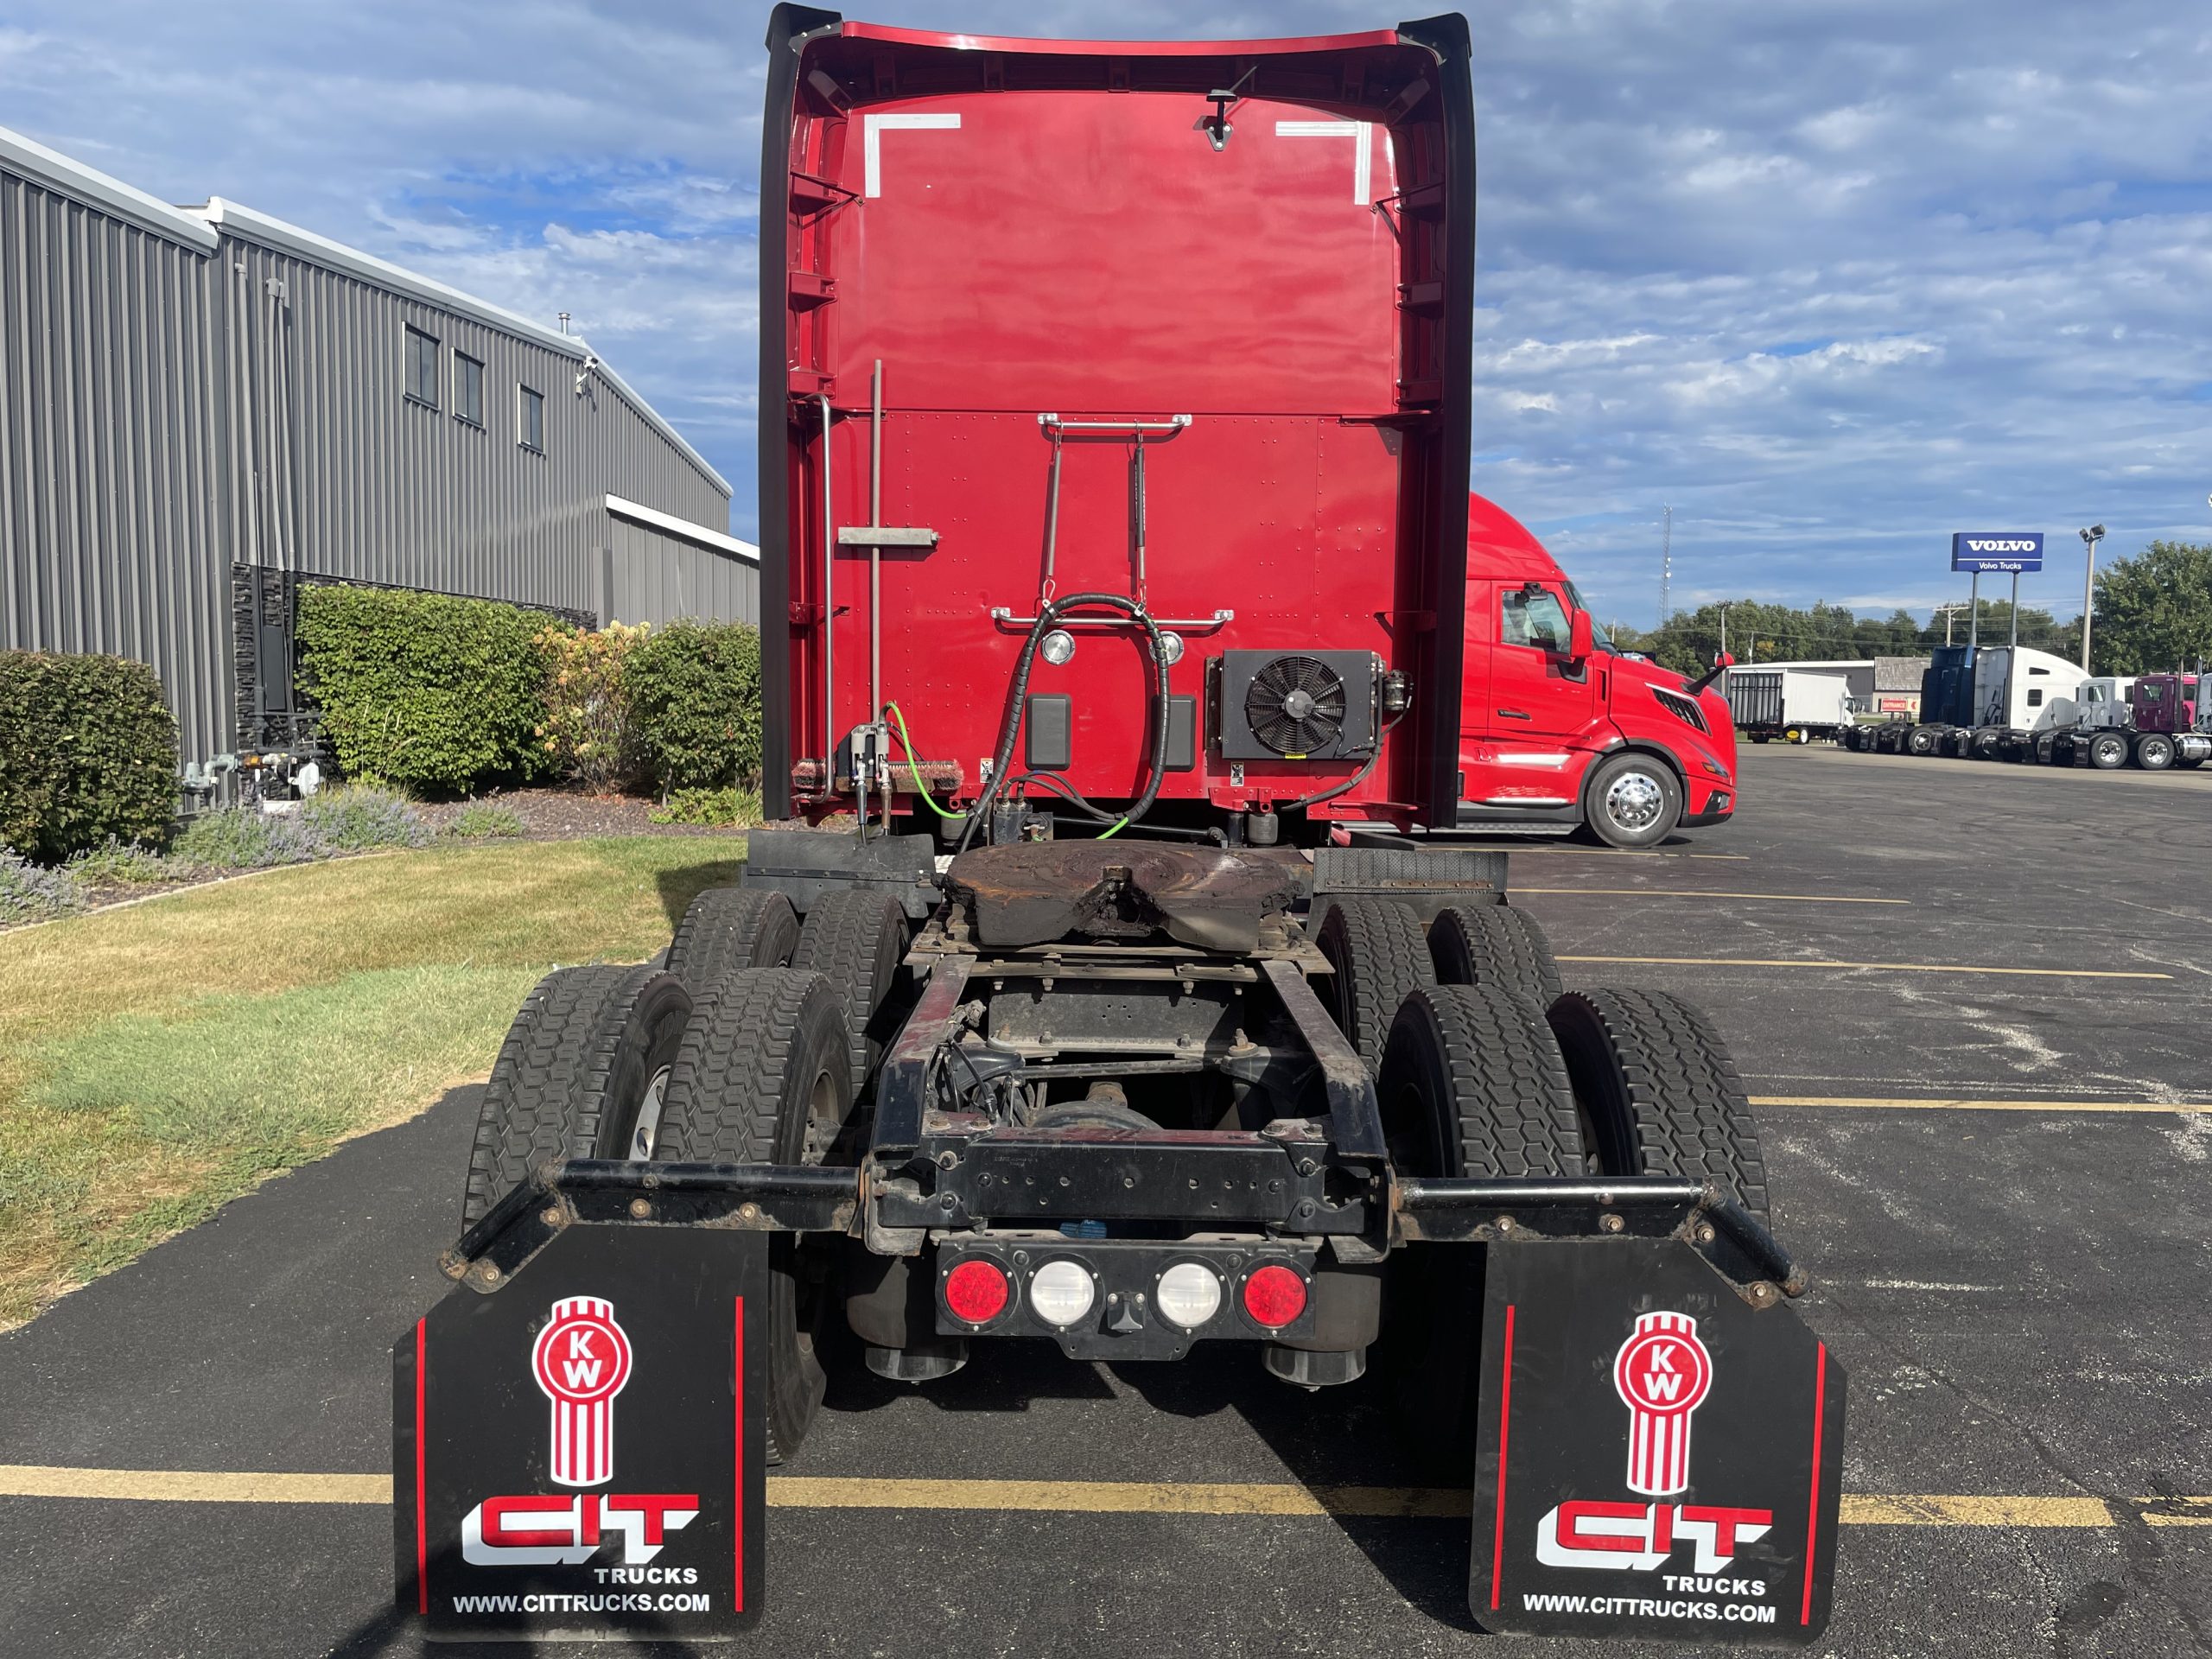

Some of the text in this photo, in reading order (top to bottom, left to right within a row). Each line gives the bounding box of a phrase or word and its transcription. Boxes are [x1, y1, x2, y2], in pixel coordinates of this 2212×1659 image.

[1967, 540, 2036, 551] VOLVO
[461, 1494, 700, 1566] CIT
[1536, 1501, 1773, 1574] CIT
[594, 1567, 698, 1585] TRUCKS
[1662, 1575, 1766, 1597] TRUCKS
[453, 1593, 710, 1613] WWW.CITTRUCKS.COM
[1522, 1592, 1777, 1624] WWW.CITTRUCKS.COM
